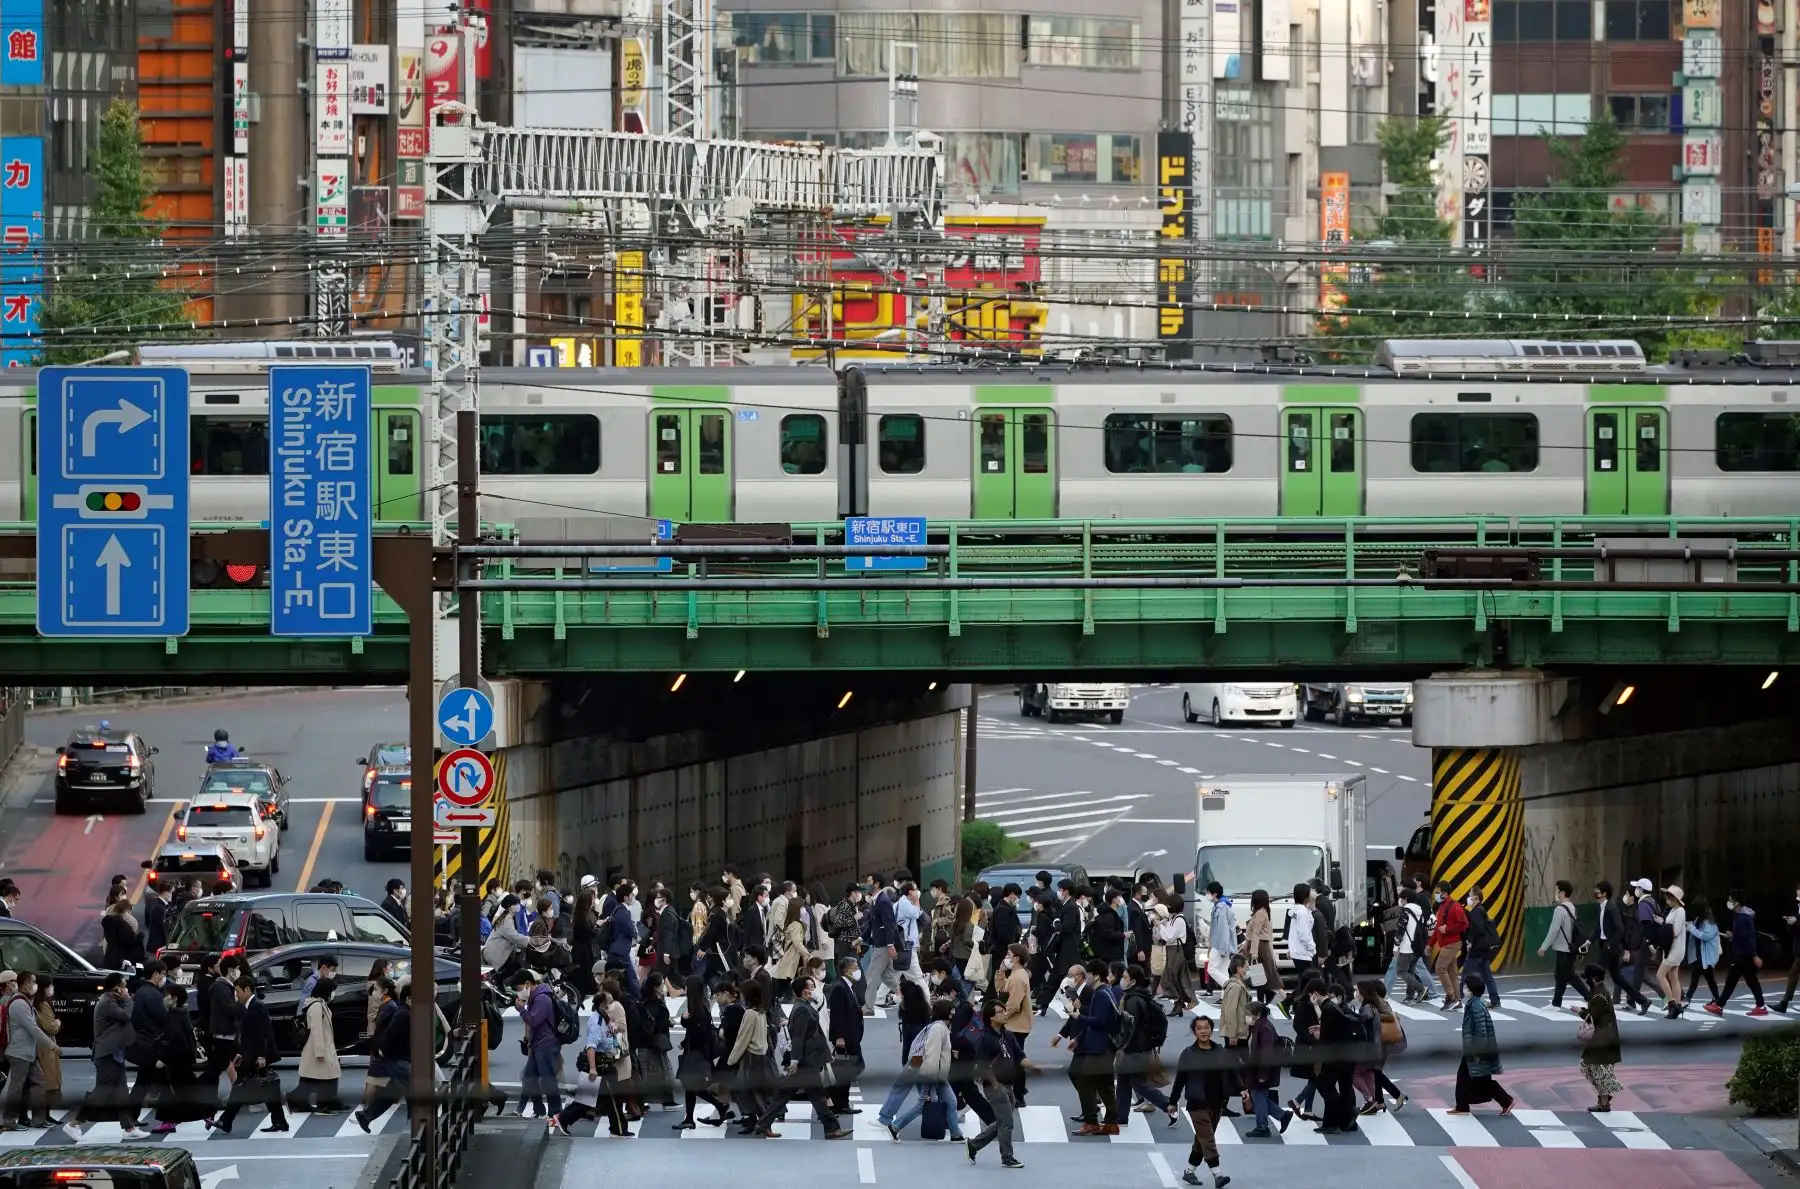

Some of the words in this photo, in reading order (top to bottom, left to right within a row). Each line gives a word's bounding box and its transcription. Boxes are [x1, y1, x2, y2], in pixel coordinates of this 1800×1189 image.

[8, 29, 37, 60] 館
[326, 67, 338, 116] お好み焼
[398, 132, 422, 154] たばこ
[323, 227, 341, 235] ATM
[1468, 198, 1486, 257] ダーツ
[4, 159, 31, 368] カラオ
[959, 410, 966, 420] 3
[278, 387, 313, 507] Shinjuku
[315, 380, 359, 619] 新宿駅東口
[851, 519, 920, 534] 新宿駅東口
[853, 534, 888, 545] Shinjuku
